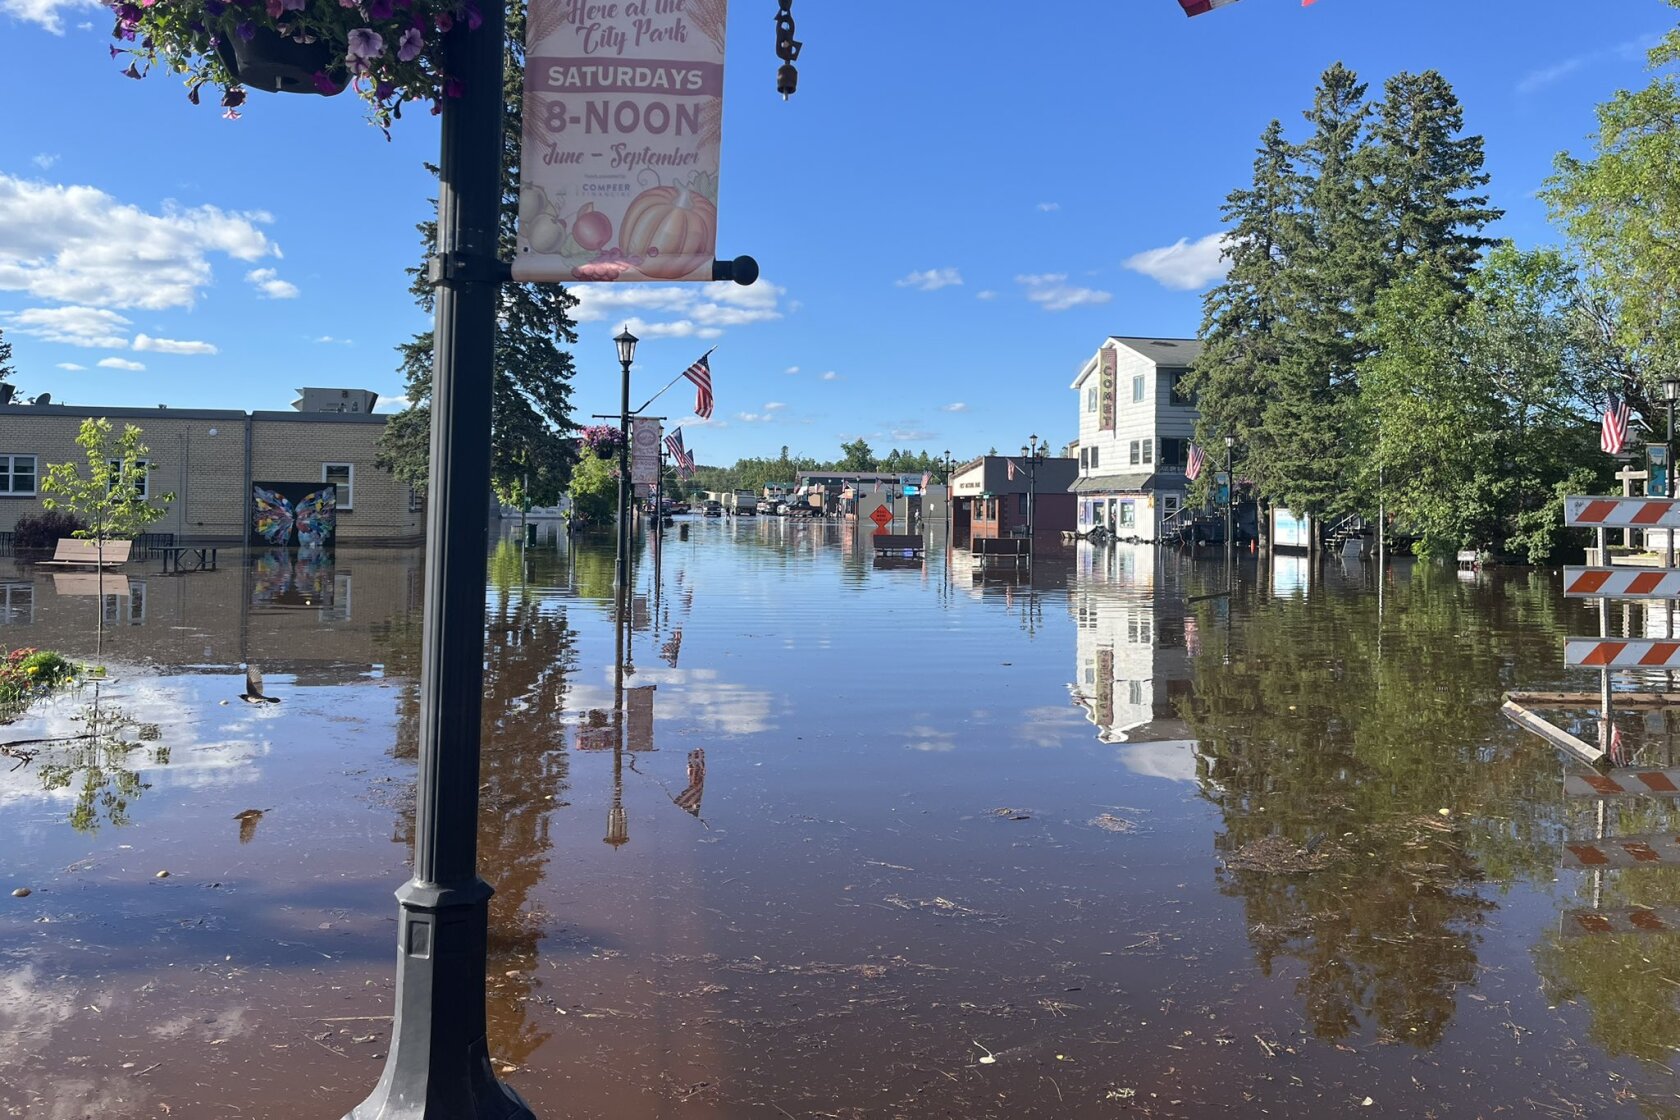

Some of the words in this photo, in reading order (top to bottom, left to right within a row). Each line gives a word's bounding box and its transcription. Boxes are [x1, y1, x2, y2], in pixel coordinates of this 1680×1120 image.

[566, 0, 618, 25] Here
[576, 22, 628, 55] City
[632, 18, 688, 47] Park
[547, 65, 703, 90] SATURDAYS
[544, 99, 700, 136] 8-NOON
[543, 141, 585, 167] June
[610, 142, 700, 171] September
[582, 183, 631, 192] COMPEER
